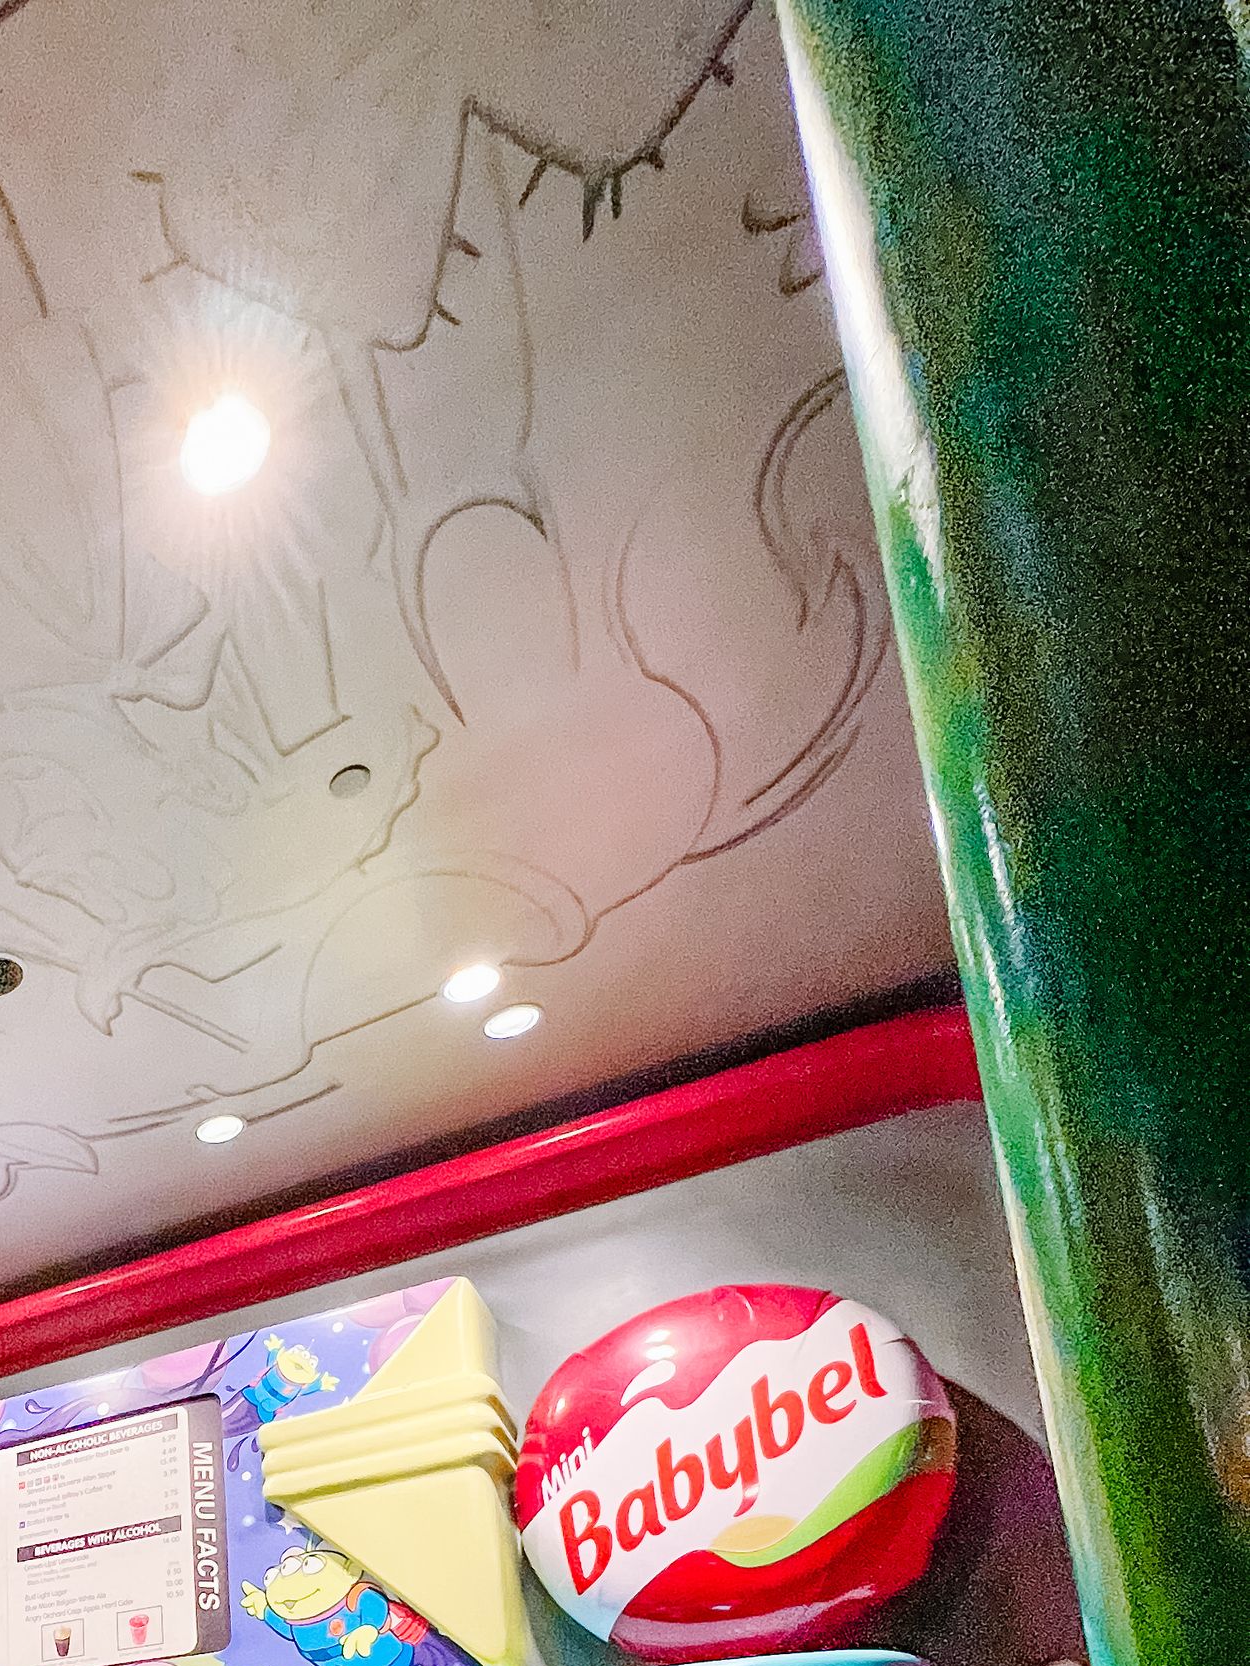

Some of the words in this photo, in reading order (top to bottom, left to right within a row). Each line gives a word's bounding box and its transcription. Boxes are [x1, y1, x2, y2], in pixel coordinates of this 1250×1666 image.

[30, 1434, 108, 1461] NON-ALCOHOLIC
[109, 1422, 163, 1443] BEVERAGES
[191, 1440, 217, 1521] MENU
[541, 1426, 595, 1501] Mini
[558, 1322, 888, 1596] Babybel
[34, 1537, 86, 1557] BEVERAGES
[87, 1530, 113, 1546] WITH
[114, 1522, 162, 1542] ALCOHOL
[195, 1527, 220, 1612] FACTS
